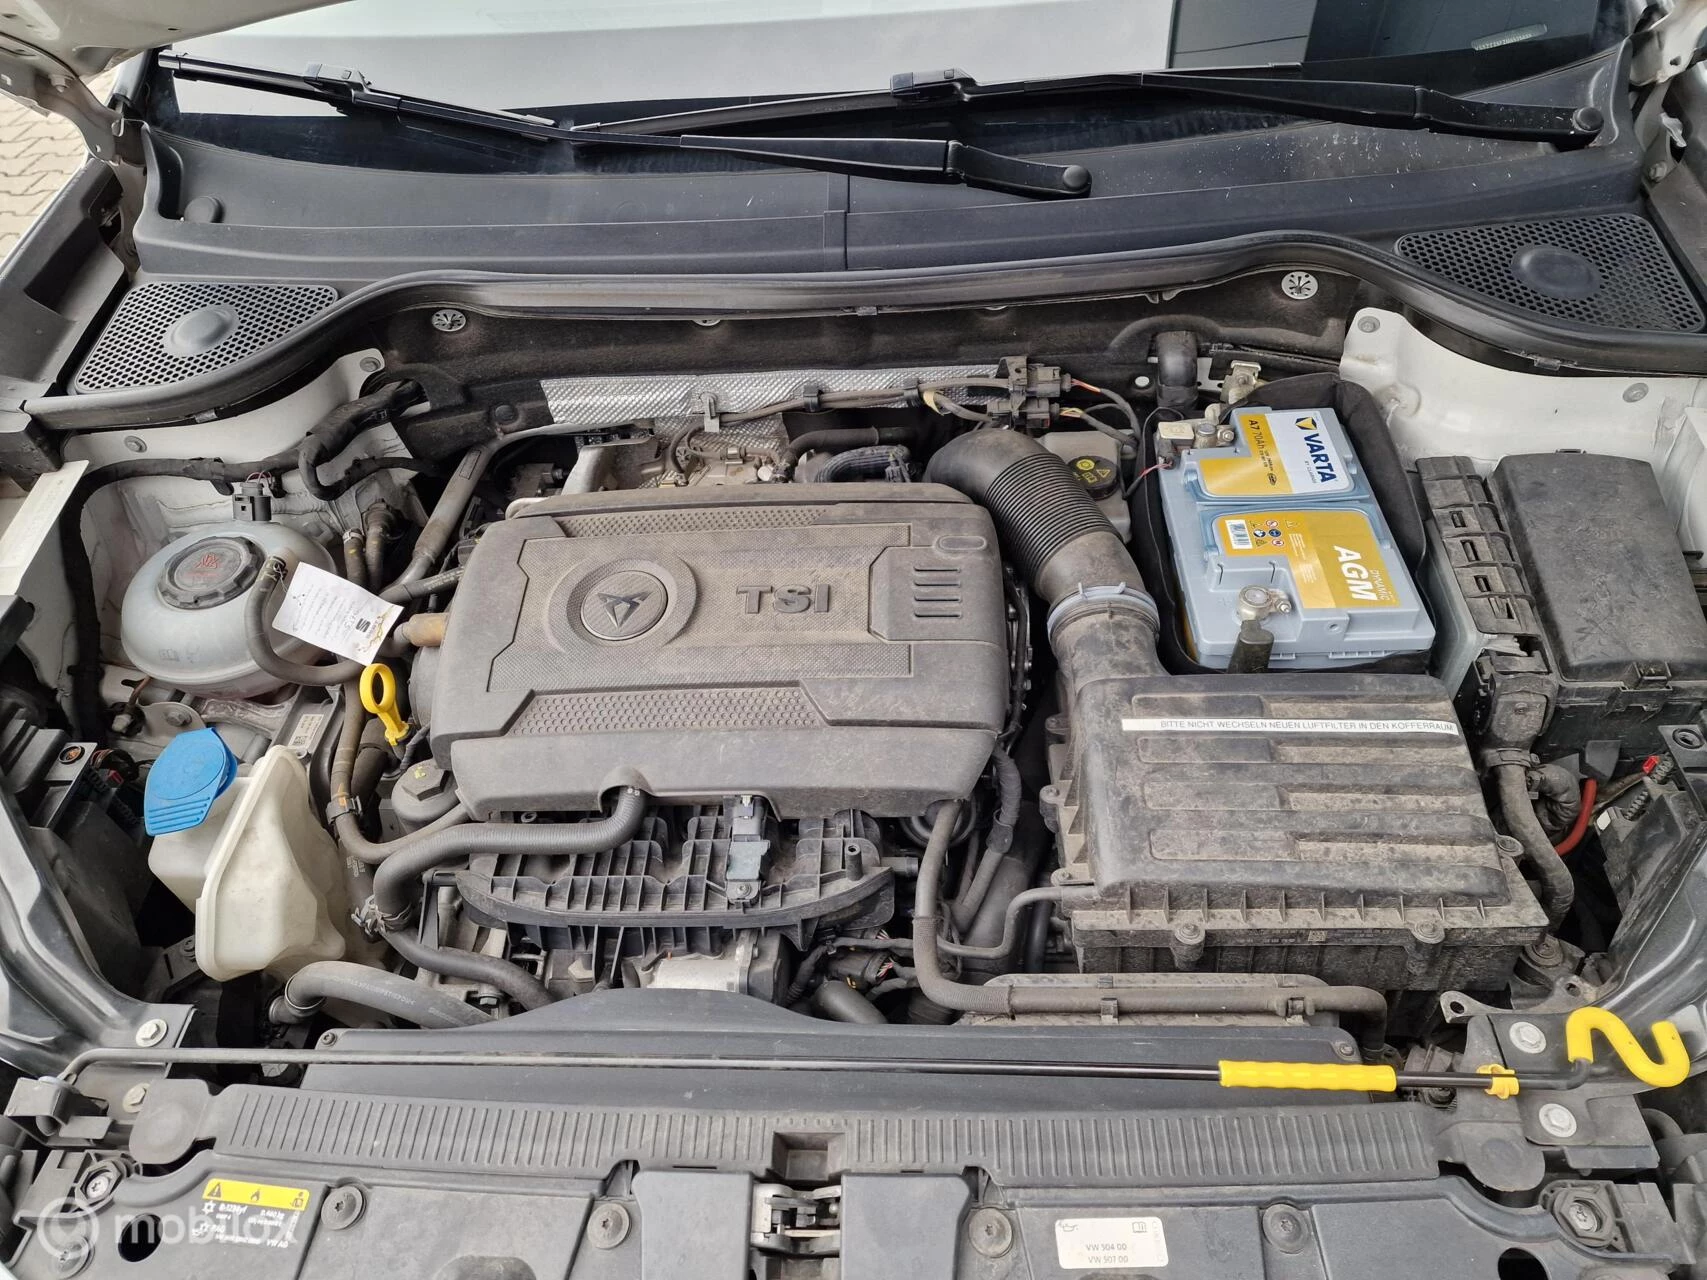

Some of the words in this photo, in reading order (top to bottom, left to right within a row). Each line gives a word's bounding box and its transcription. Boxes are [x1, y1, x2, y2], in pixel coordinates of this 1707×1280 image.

[1249, 420, 1260, 430] A7
[1251, 432, 1267, 449] 70Ah
[1304, 433, 1337, 483] VARTA
[1333, 545, 1378, 601] AGM
[1370, 569, 1390, 601] DYNAMIC
[736, 584, 831, 614] TSI
[1160, 720, 1185, 728] BITTE
[1187, 720, 1214, 729] NICHT
[1216, 720, 1267, 729] WECHSELN
[1269, 721, 1300, 729] NEUEN
[1302, 721, 1356, 730] LUFTFILTER
[1359, 722, 1367, 730] IN
[1370, 722, 1389, 730] DEN
[1392, 722, 1454, 731] KOFFERRAUM
[1086, 1243, 1099, 1251] VW
[1088, 1256, 1101, 1264] VW
